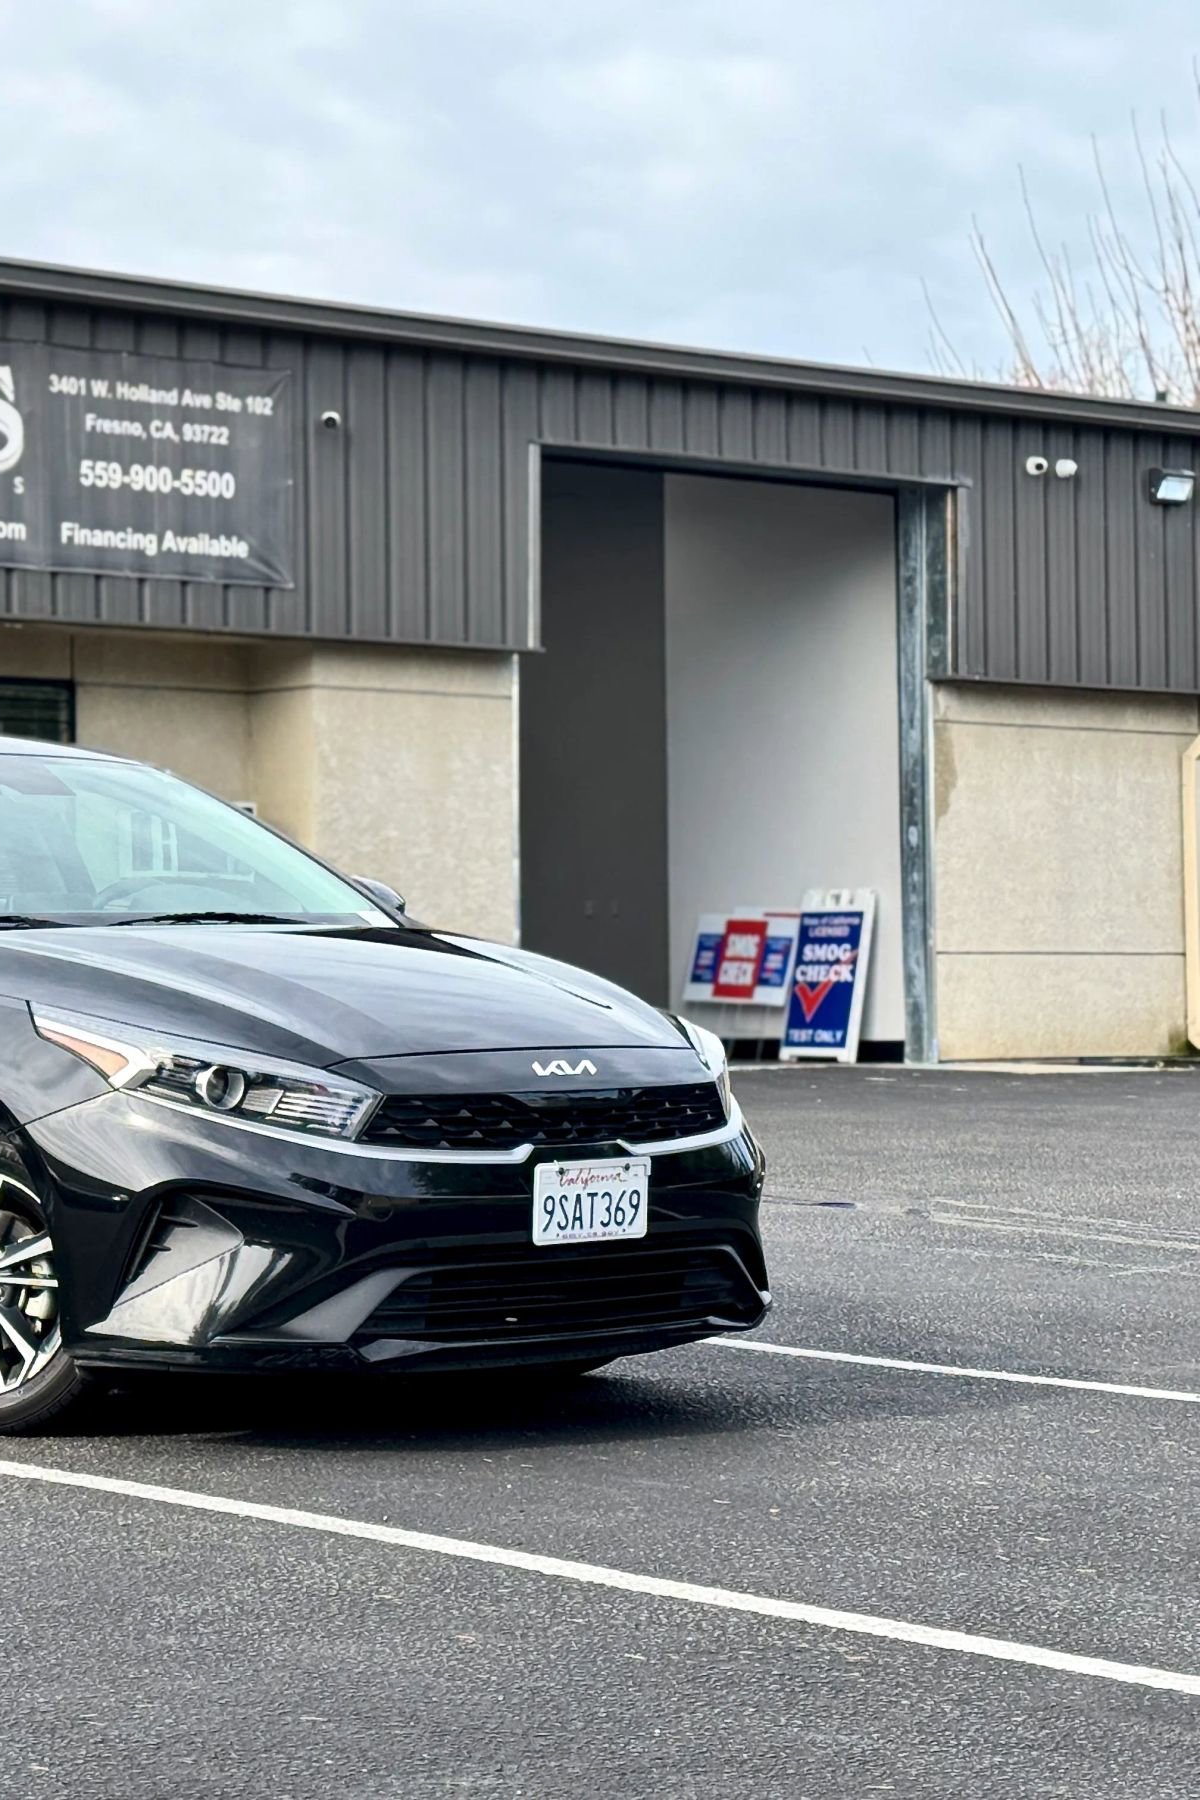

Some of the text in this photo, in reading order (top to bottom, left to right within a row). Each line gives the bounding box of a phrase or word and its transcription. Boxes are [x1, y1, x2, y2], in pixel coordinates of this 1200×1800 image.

[49, 374, 86, 396] 3401
[90, 379, 113, 399] W.
[116, 382, 178, 406] Holland
[181, 389, 213, 409] Ave
[215, 392, 243, 413] Ste
[85, 413, 230, 446] Fresno, CA, 93722
[79, 459, 236, 500] 559-900-5500
[60, 521, 250, 559] Financing Available
[802, 943, 852, 962] SMOG
[795, 965, 854, 982] CHECK
[788, 1028, 844, 1044] TEST ONLY
[542, 1189, 641, 1233] 9SAT369
